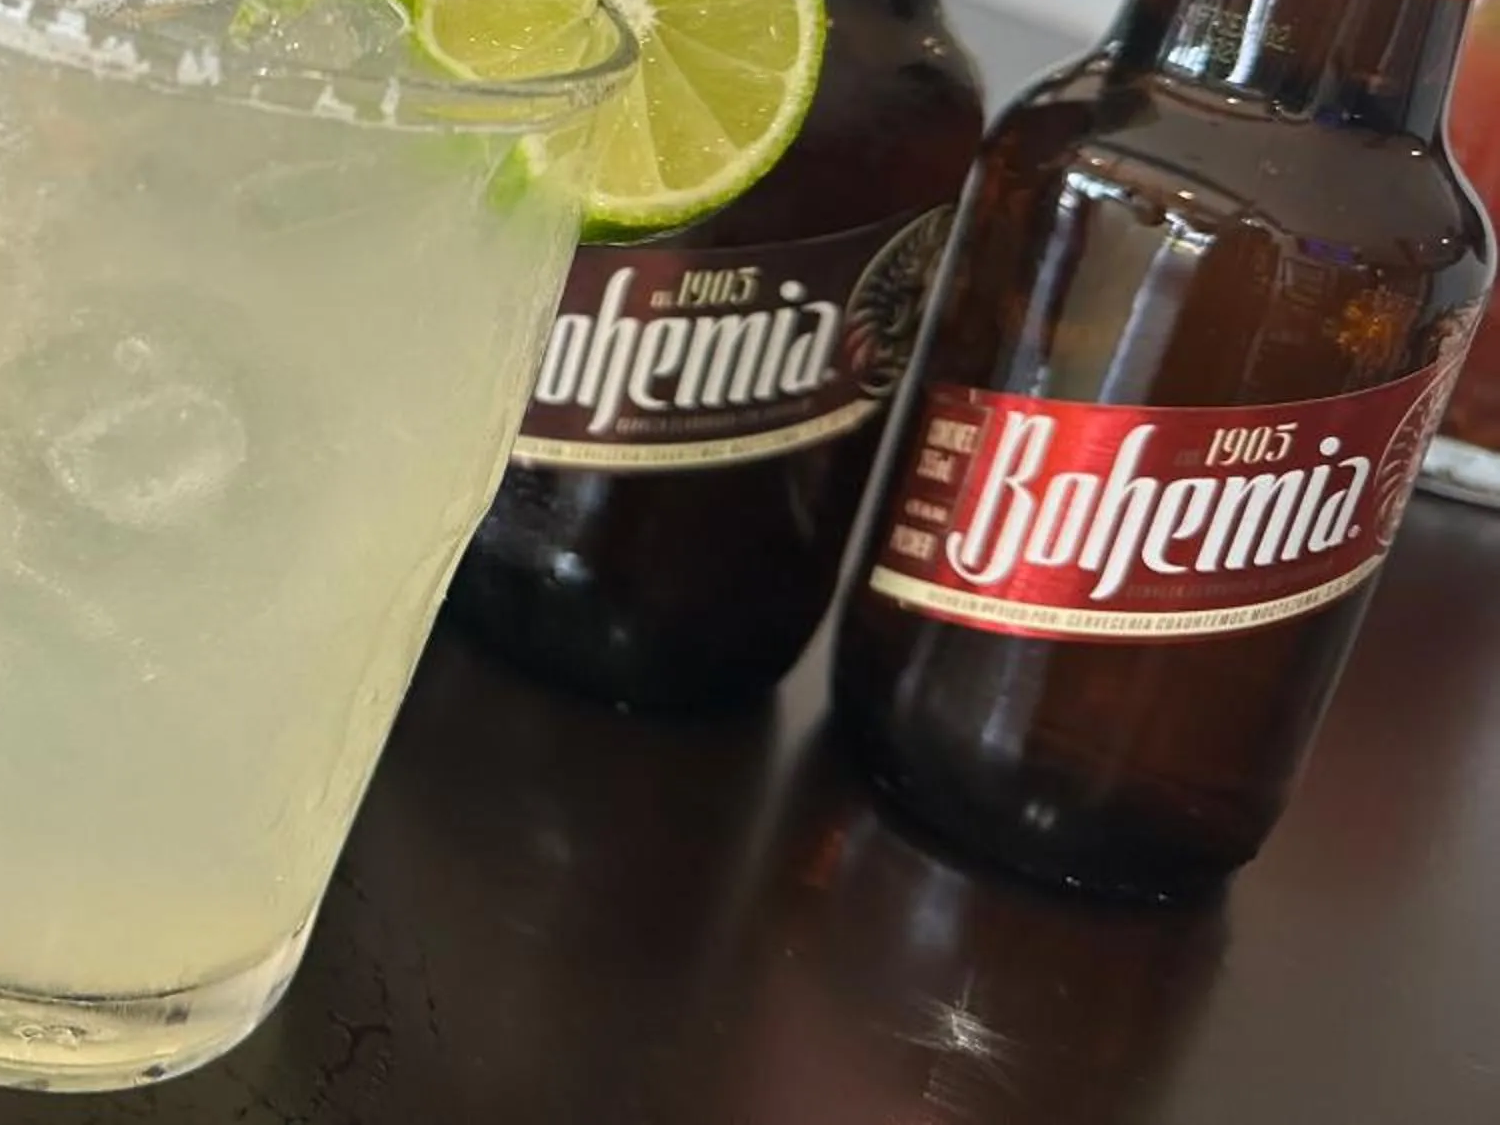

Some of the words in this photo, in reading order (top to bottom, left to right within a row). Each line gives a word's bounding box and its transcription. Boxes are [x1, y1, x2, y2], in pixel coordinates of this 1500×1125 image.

[677, 266, 760, 308] 1905
[535, 266, 841, 436] ohemia
[1204, 422, 1299, 467] 1905
[945, 410, 1371, 601] Bohemia
